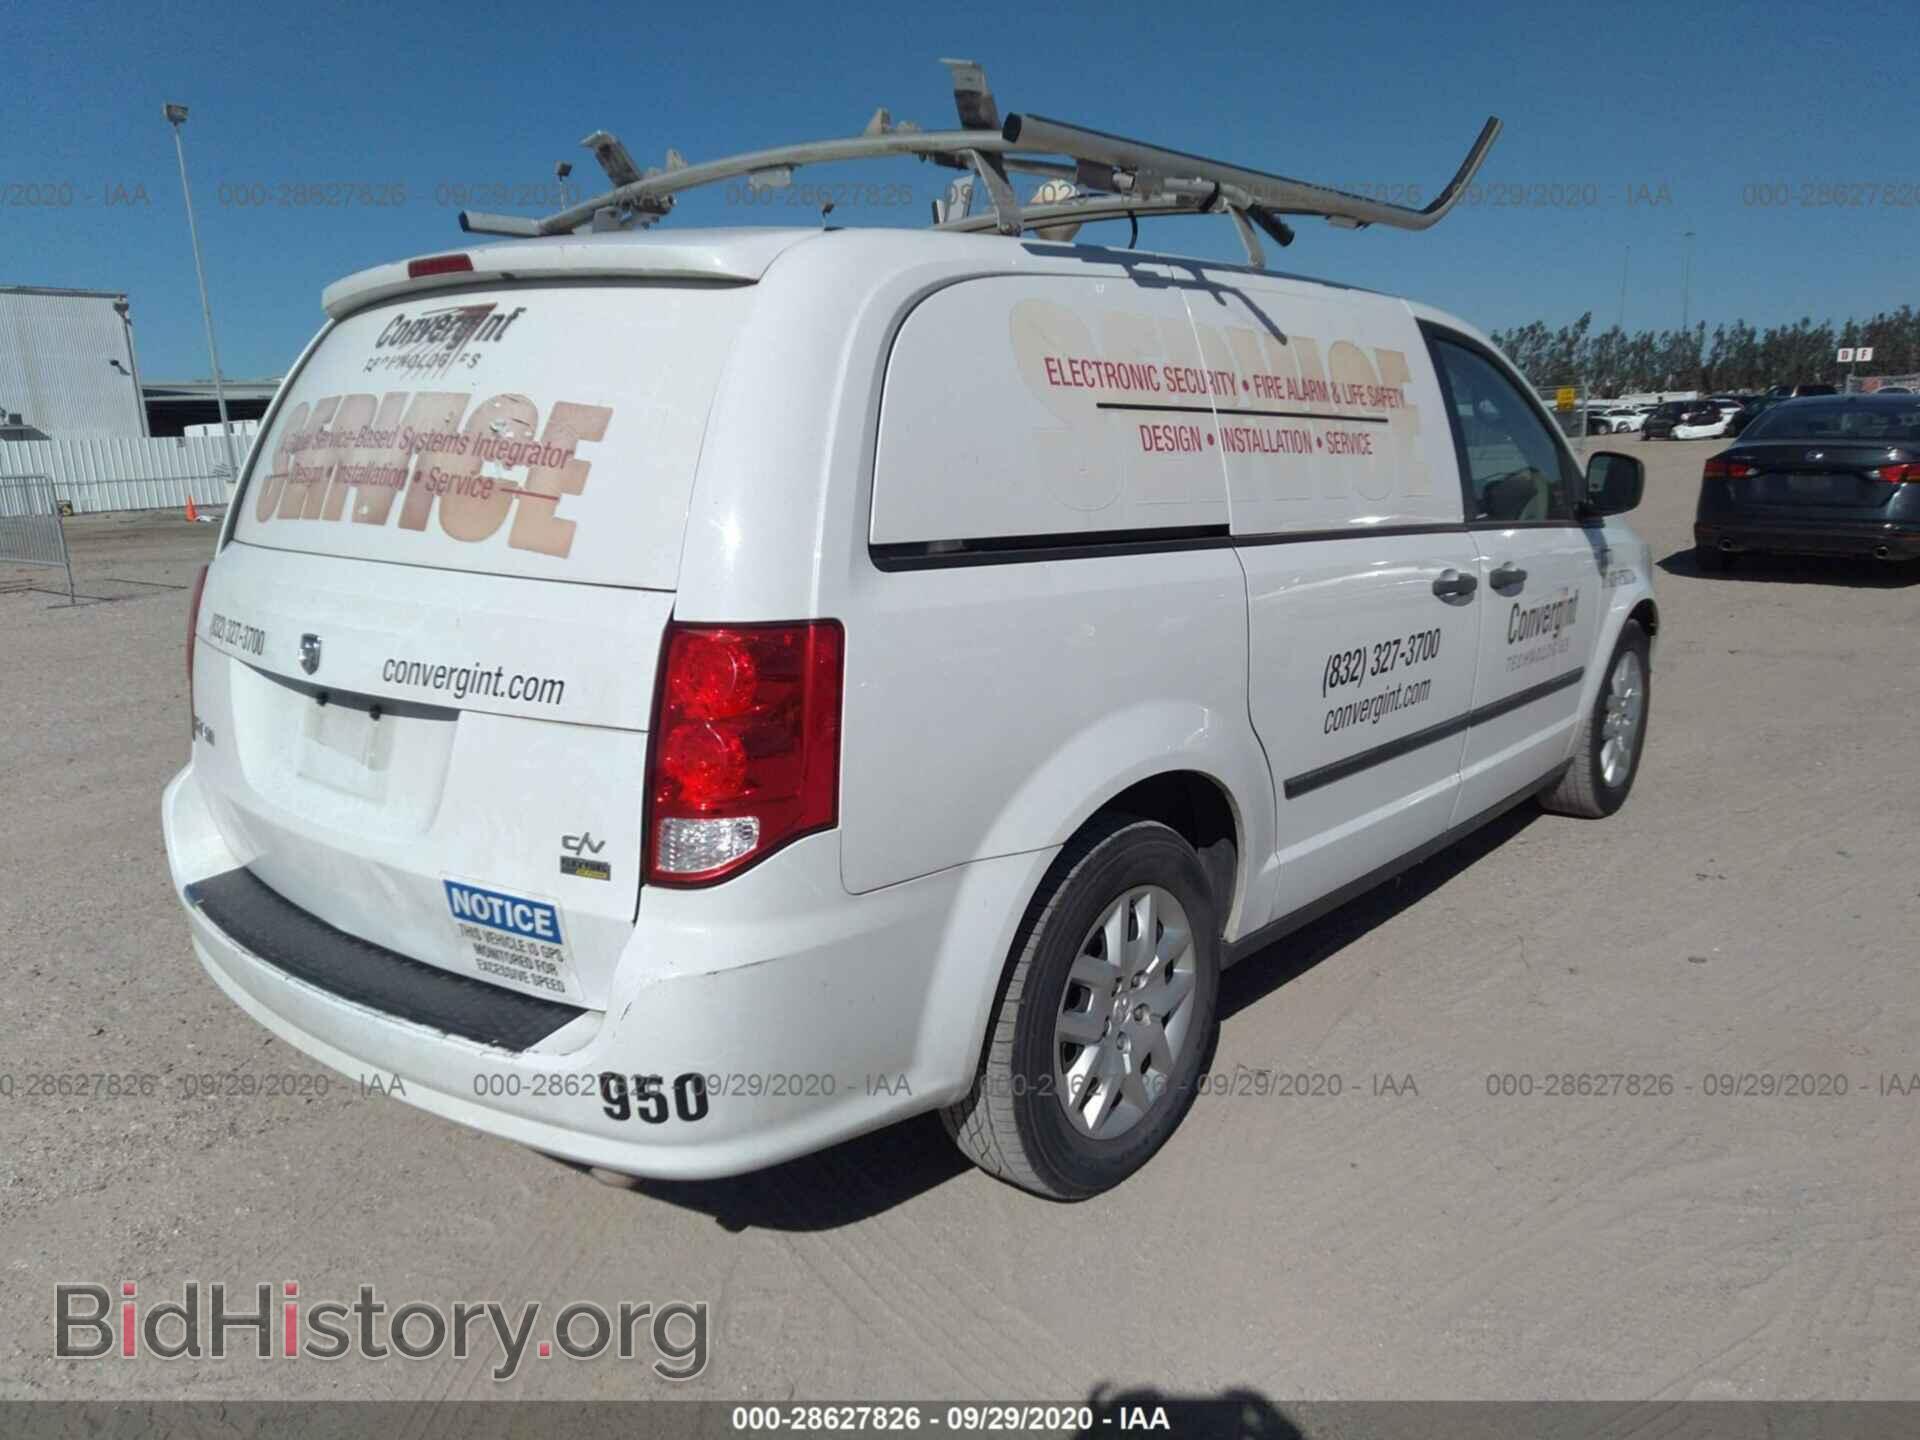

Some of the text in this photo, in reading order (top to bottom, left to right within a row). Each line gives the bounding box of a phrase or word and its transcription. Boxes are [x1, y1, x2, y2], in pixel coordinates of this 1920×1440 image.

[1044, 356, 1160, 391] ELECTRONIC
[1163, 366, 1237, 396] SECURITY
[1253, 374, 1285, 399] FIRE
[1287, 378, 1330, 402] ALARM
[1331, 382, 1342, 404] &
[1343, 383, 1368, 406] LIFE
[401, 424, 469, 458] Systems
[472, 431, 575, 469] Integrator
[1140, 425, 1374, 456] DESIGN INSTALLATION SERVICE
[336, 461, 408, 492] Installation
[426, 466, 495, 500] Service
[383, 658, 565, 704] convergint.com
[1322, 628, 1441, 698] (832) 327-3700
[1324, 679, 1432, 735] convergint.com
[451, 887, 554, 938] NOTICE
[531, 972, 566, 993] SPEED
[600, 1071, 710, 1125] 950
